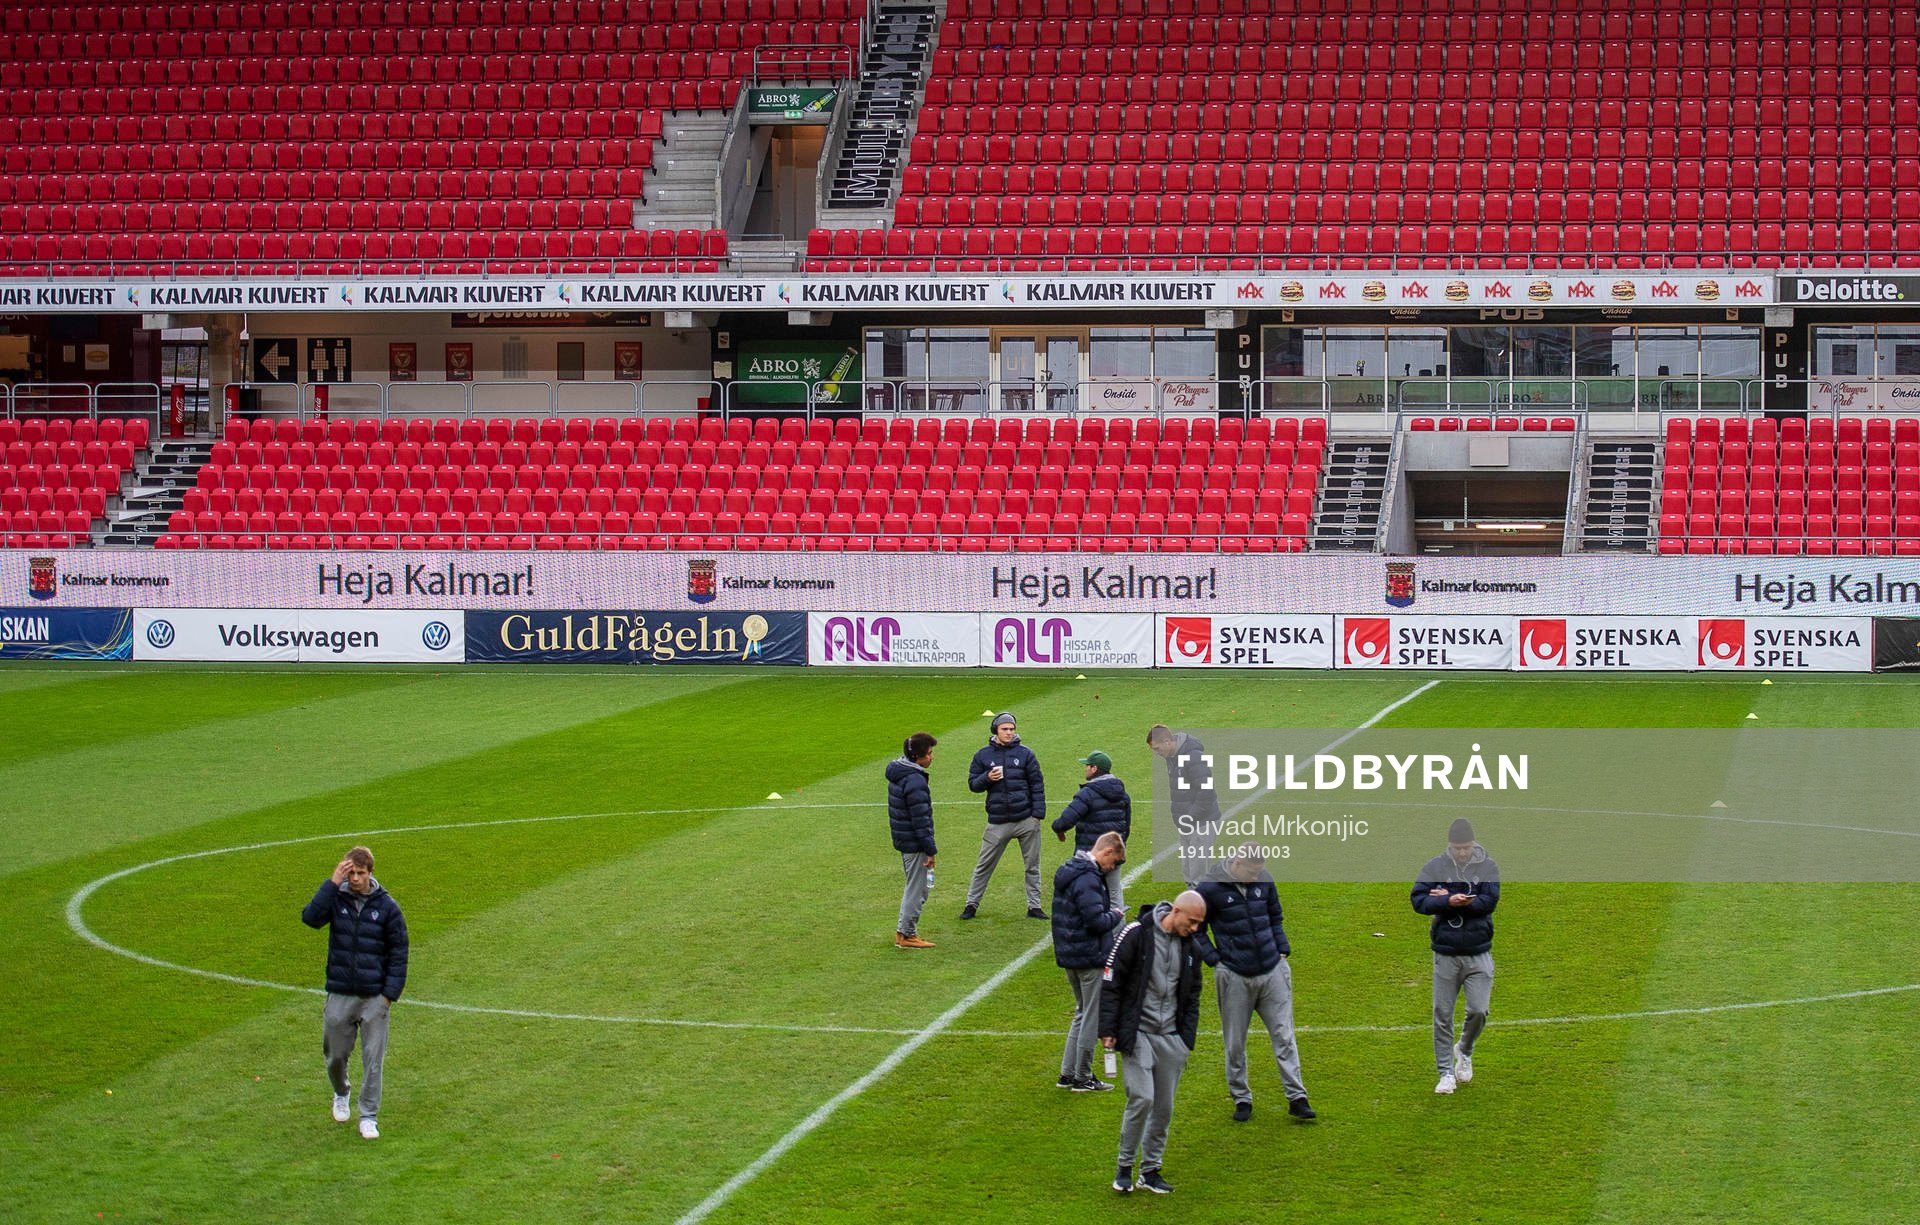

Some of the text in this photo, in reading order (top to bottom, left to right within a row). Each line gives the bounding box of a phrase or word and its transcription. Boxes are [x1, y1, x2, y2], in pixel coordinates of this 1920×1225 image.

[758, 93, 788, 103] ÅBRO
[36, 288, 116, 305] KUVERT
[151, 287, 329, 304] KALMAR KUVERT
[364, 286, 545, 303] KALMAR KUVERT
[581, 285, 766, 302] KALMAR KUVERT
[802, 284, 990, 302] KALMAR KUVERT
[1026, 283, 1216, 301] KALMAR KUVERT
[1237, 281, 1265, 299] MAX
[1319, 281, 1346, 299] MAX
[1402, 281, 1429, 299] MAX
[1484, 280, 1512, 298] MAX
[1567, 280, 1595, 298] MAX
[1651, 280, 1679, 298] MAX
[1735, 280, 1763, 297] MAX
[1797, 279, 1904, 300] Deloitte.
[749, 357, 799, 373] ÅBRO
[1238, 334, 1251, 388] PUB
[1775, 333, 1788, 389] PUB
[1103, 388, 1137, 399] Onside
[1163, 382, 1210, 397] The Players
[1173, 394, 1196, 407] Pub
[62, 573, 169, 587] Kalmar kommun
[318, 563, 533, 603] Heja Kalmar!
[722, 576, 835, 590] Kalmar kommun
[992, 565, 1217, 607] Heja Kalmar!
[1421, 579, 1537, 593] Kalmar kommun
[1735, 574, 1817, 610] Heja
[0, 617, 49, 640] SKAN
[500, 613, 739, 660] GuldFågeln
[1220, 626, 1325, 645] SVENSKA
[1398, 628, 1503, 645] SVENSKA
[218, 623, 379, 653] Volkswagen
[824, 616, 900, 662] ALT
[892, 639, 940, 650] HISSAR &
[994, 617, 1072, 664] ALT
[1063, 640, 1111, 651] HISSAR &
[1575, 629, 1681, 646] SVENSKA
[1753, 629, 1861, 646] SVENSKA
[892, 651, 965, 663] RULLTRAPPOR
[1063, 652, 1137, 664] RULLTRAPPOR
[1220, 647, 1274, 665] SPEL
[1398, 648, 1453, 665] SPEL
[1575, 649, 1630, 666] SPEL
[1753, 650, 1809, 667] SPEL
